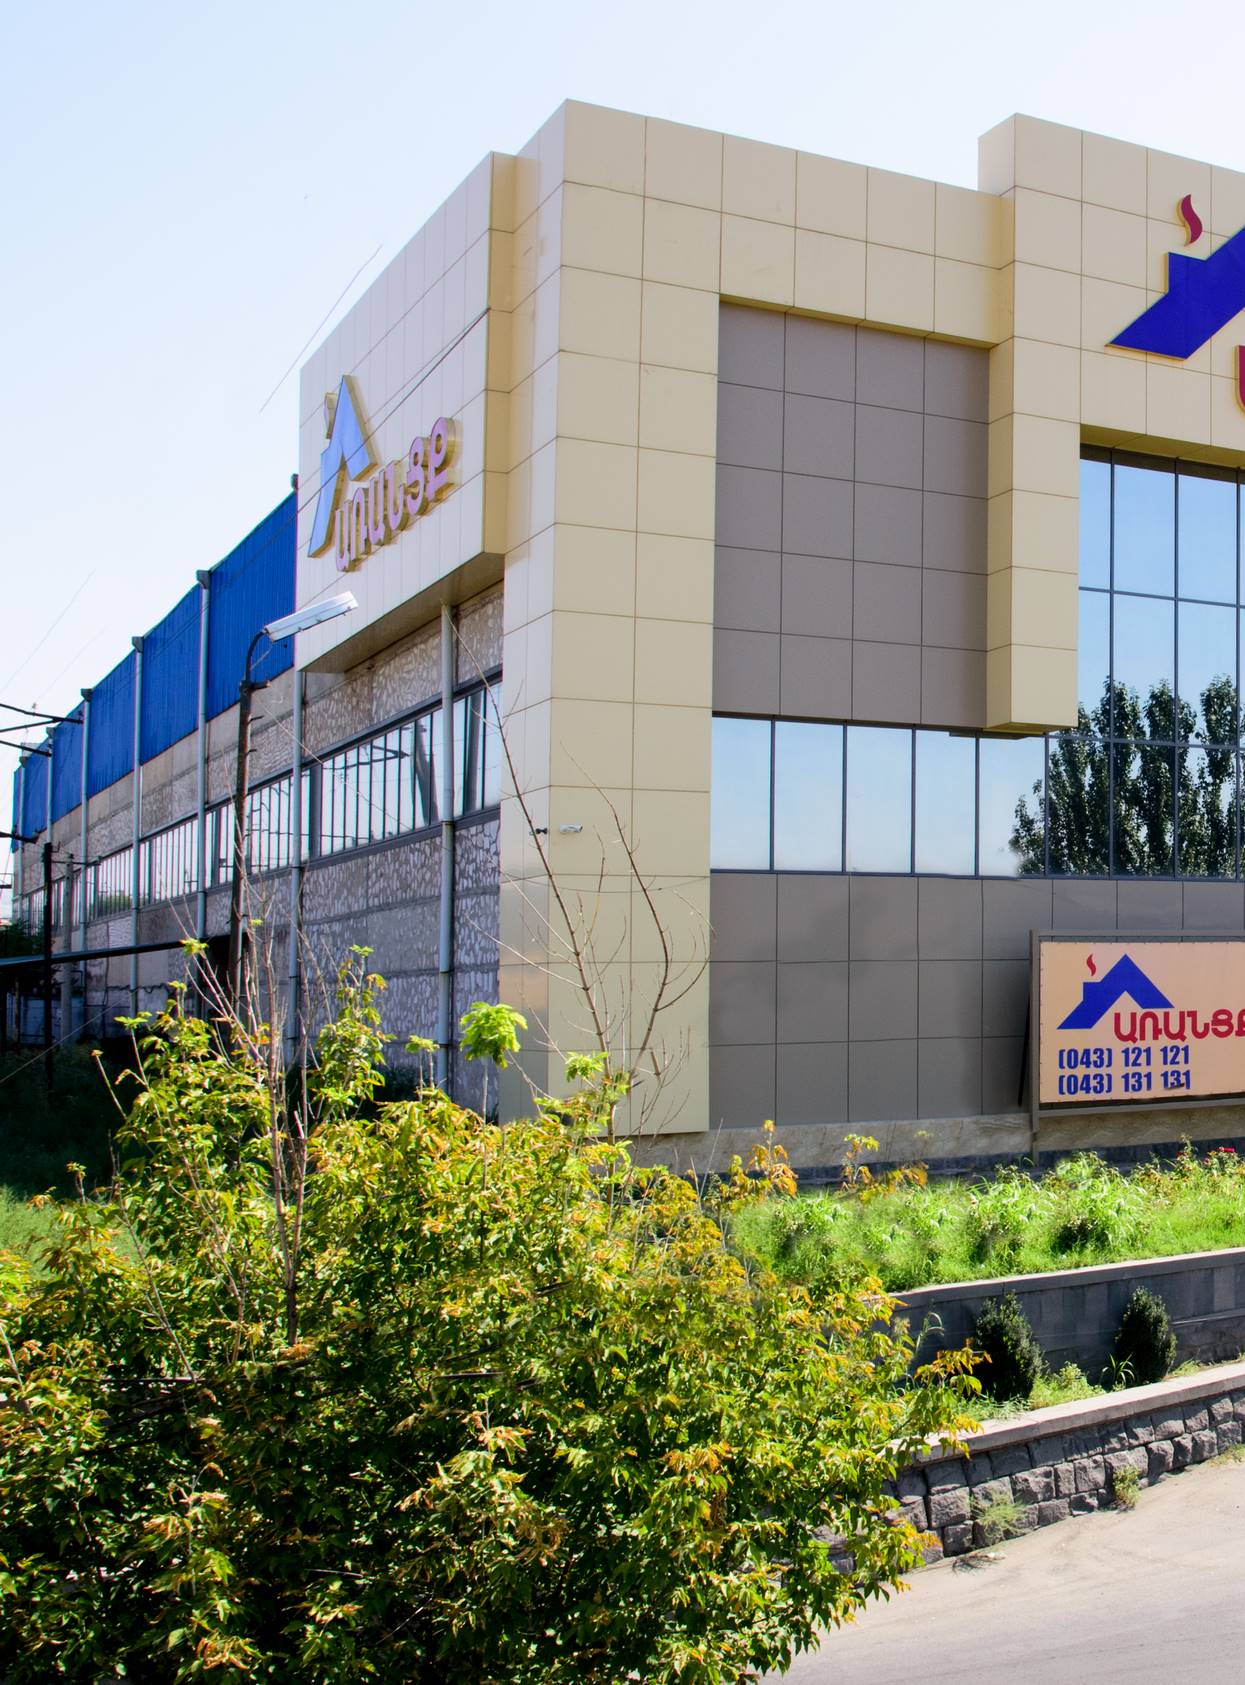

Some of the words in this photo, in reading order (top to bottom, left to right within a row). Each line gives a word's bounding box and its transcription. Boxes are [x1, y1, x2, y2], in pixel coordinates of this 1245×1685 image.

[1058, 1048, 1113, 1070] (043)
[1121, 1046, 1152, 1067] 121
[1160, 1044, 1190, 1065] 121
[1058, 1074, 1113, 1095] (043)
[1121, 1071, 1152, 1092] 131
[1160, 1069, 1191, 1090] 131
